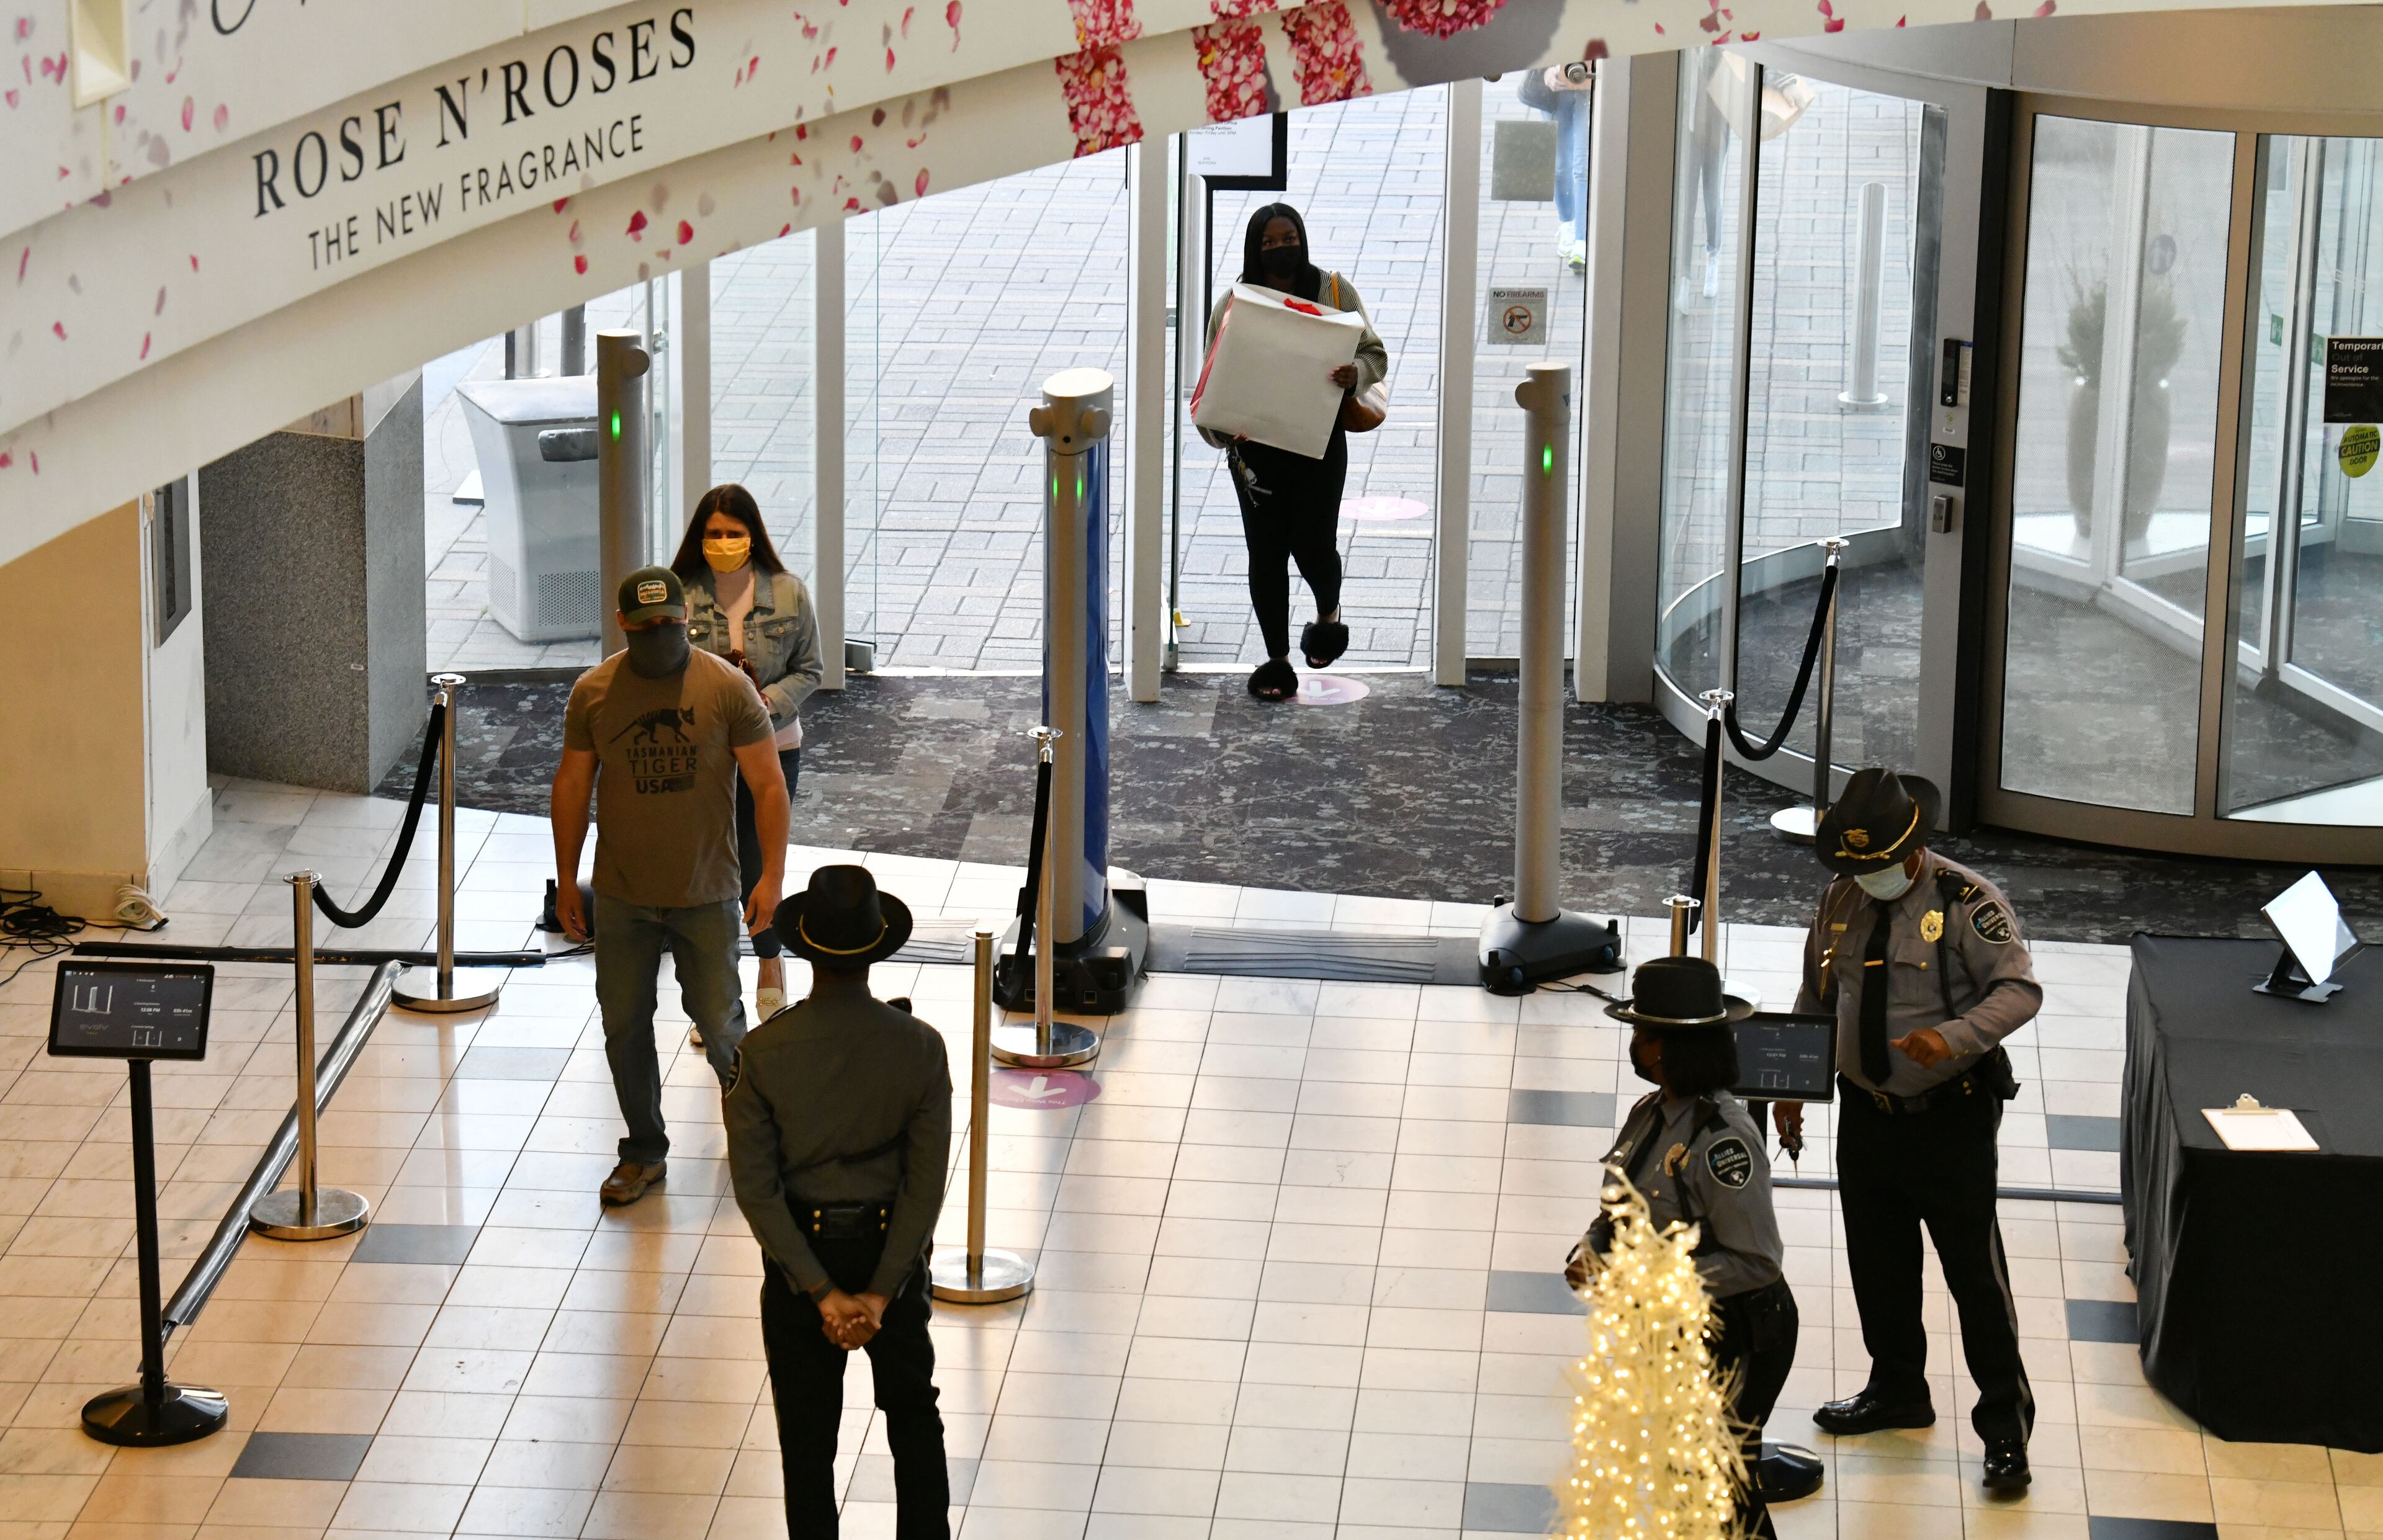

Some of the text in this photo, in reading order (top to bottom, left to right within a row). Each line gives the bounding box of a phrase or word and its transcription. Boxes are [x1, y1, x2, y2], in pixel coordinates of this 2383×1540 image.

[253, 8, 696, 218] ROSE N'ROSES
[308, 114, 644, 271] THE NEW FRAGRANCE
[2332, 353, 2363, 361] Out of
[2331, 364, 2369, 374] Service
[2343, 431, 2378, 443] AUTOMATIC
[2341, 440, 2378, 457] CAUTION
[2349, 456, 2367, 465] DOOR
[626, 745, 697, 759] TASMANIAN
[629, 758, 697, 774] TIGER
[635, 779, 673, 794] USA
[1714, 1148, 1735, 1160] ALLIED
[1717, 1152, 1748, 1168] UNIVERSAL
